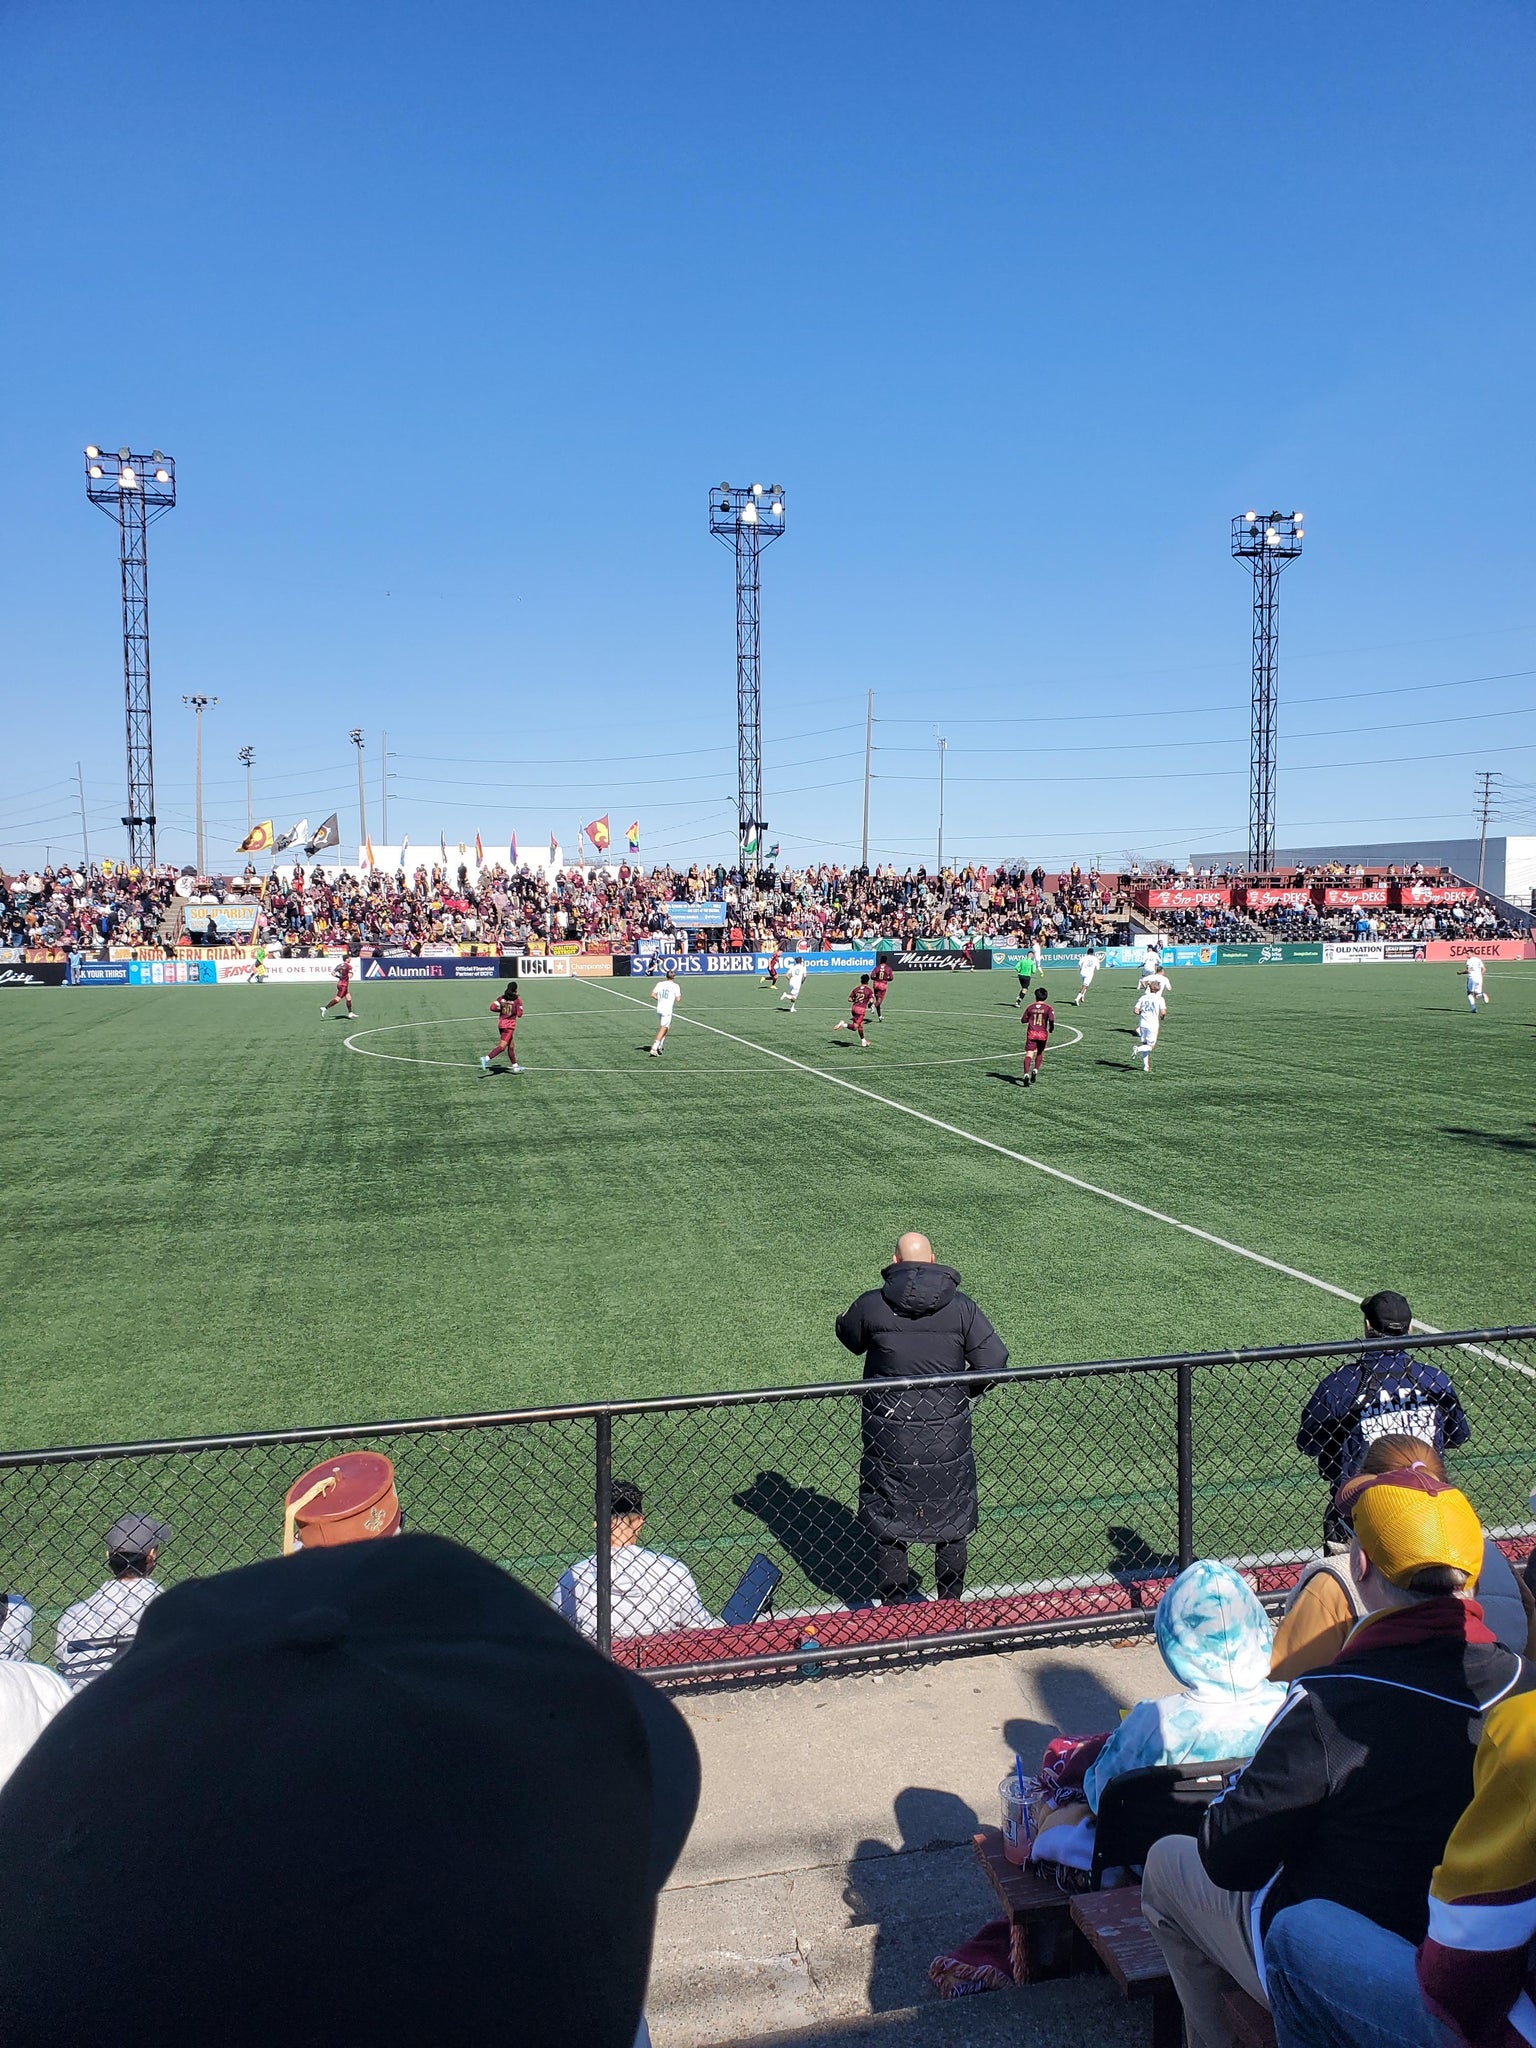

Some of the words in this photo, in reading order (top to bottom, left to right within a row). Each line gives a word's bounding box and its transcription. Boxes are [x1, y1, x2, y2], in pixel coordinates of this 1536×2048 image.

[139, 948, 202, 961] NORERN
[521, 959, 553, 975] USL
[571, 963, 610, 971] Championship
[707, 955, 754, 972] BEER
[802, 958, 829, 968] ports
[831, 957, 874, 967] Medicine
[87, 970, 104, 979] YOUR
[104, 969, 127, 978] THIRST
[388, 965, 444, 977] AlumniFi
[1033, 1013, 1043, 1026] 14
